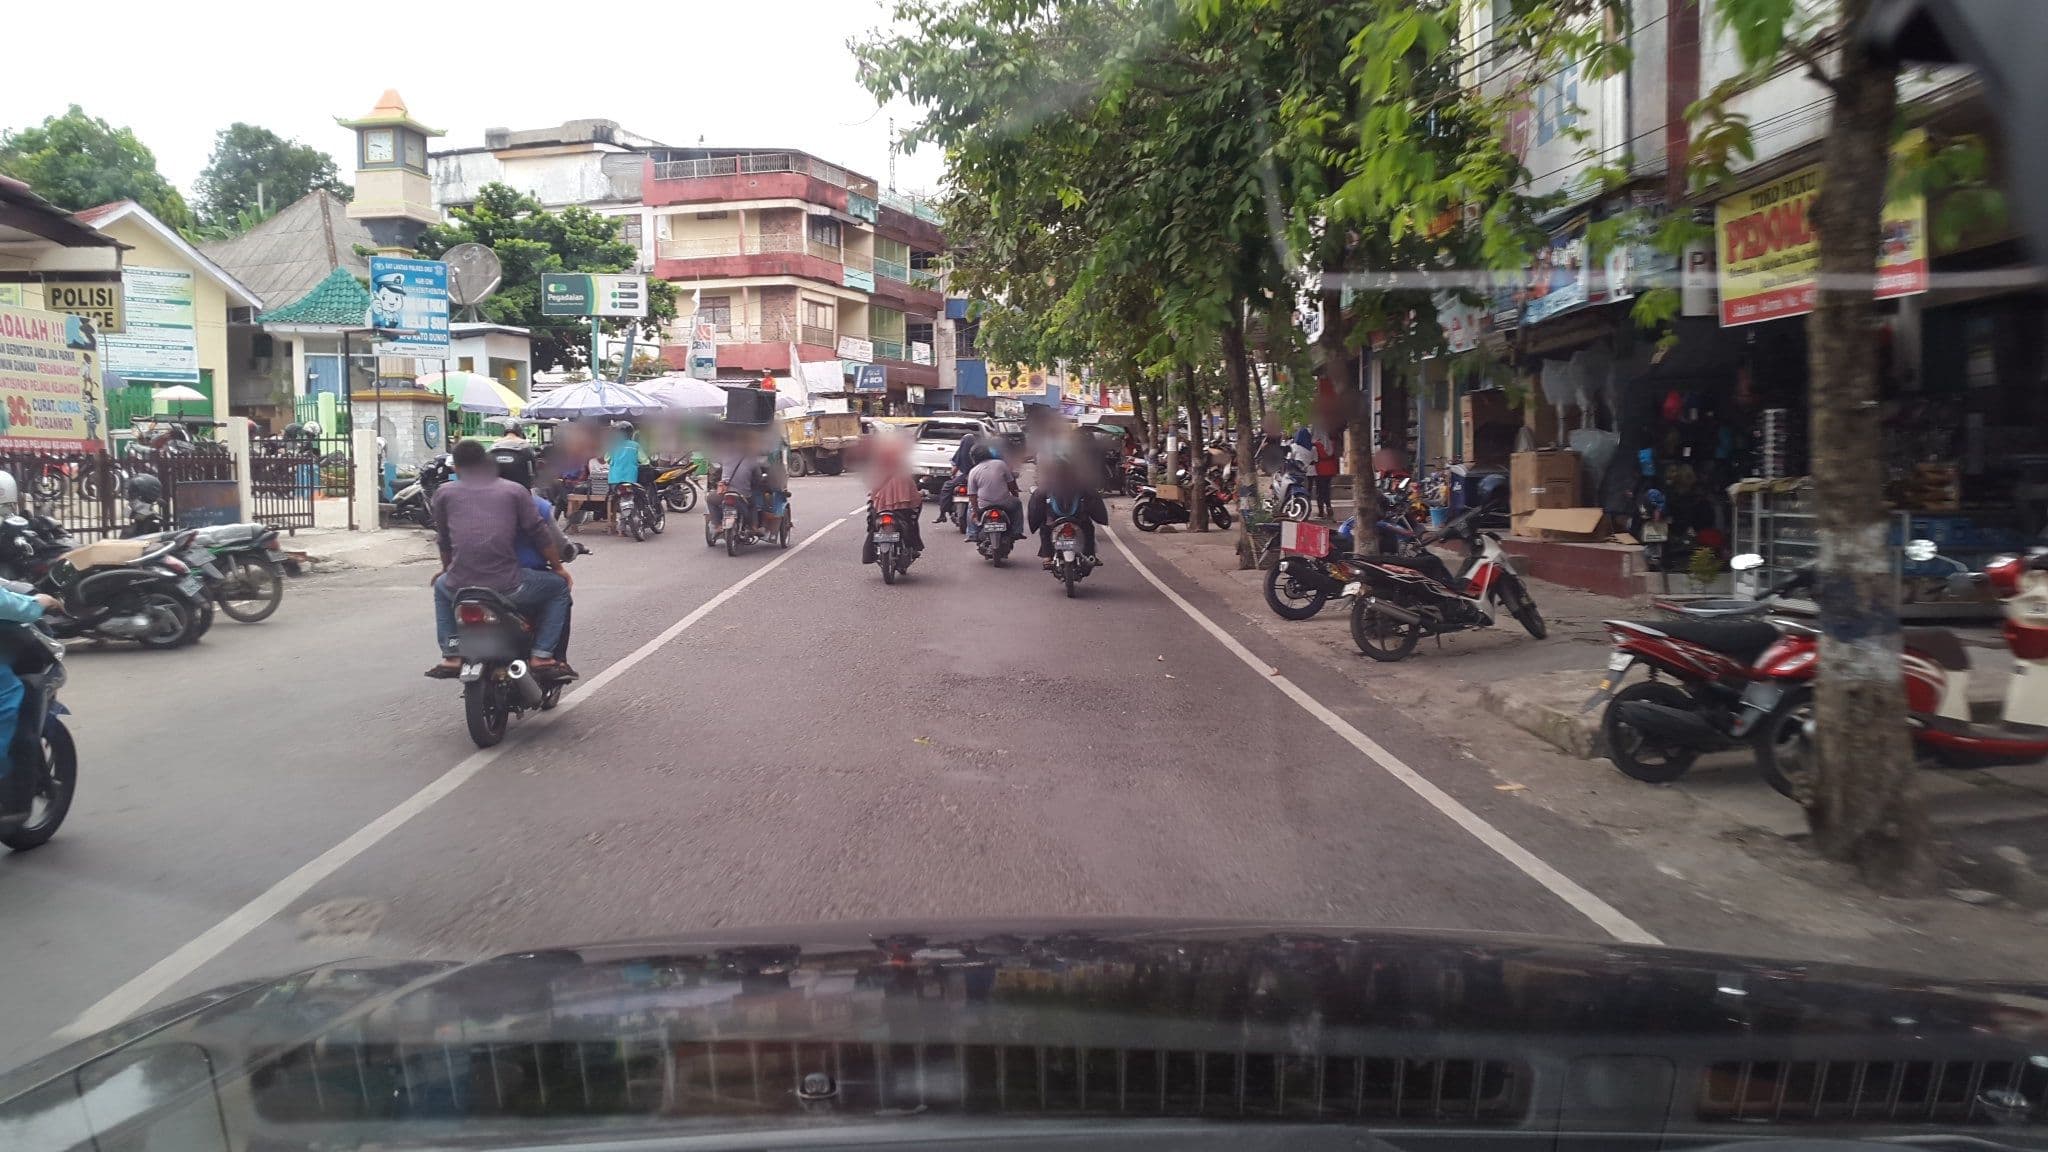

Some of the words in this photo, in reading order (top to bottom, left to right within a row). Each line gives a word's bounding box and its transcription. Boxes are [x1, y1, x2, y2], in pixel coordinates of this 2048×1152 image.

[52, 288, 113, 306] POLISI
[547, 293, 585, 303] Pegadaian
[34, 416, 74, 431] CURANMOR
